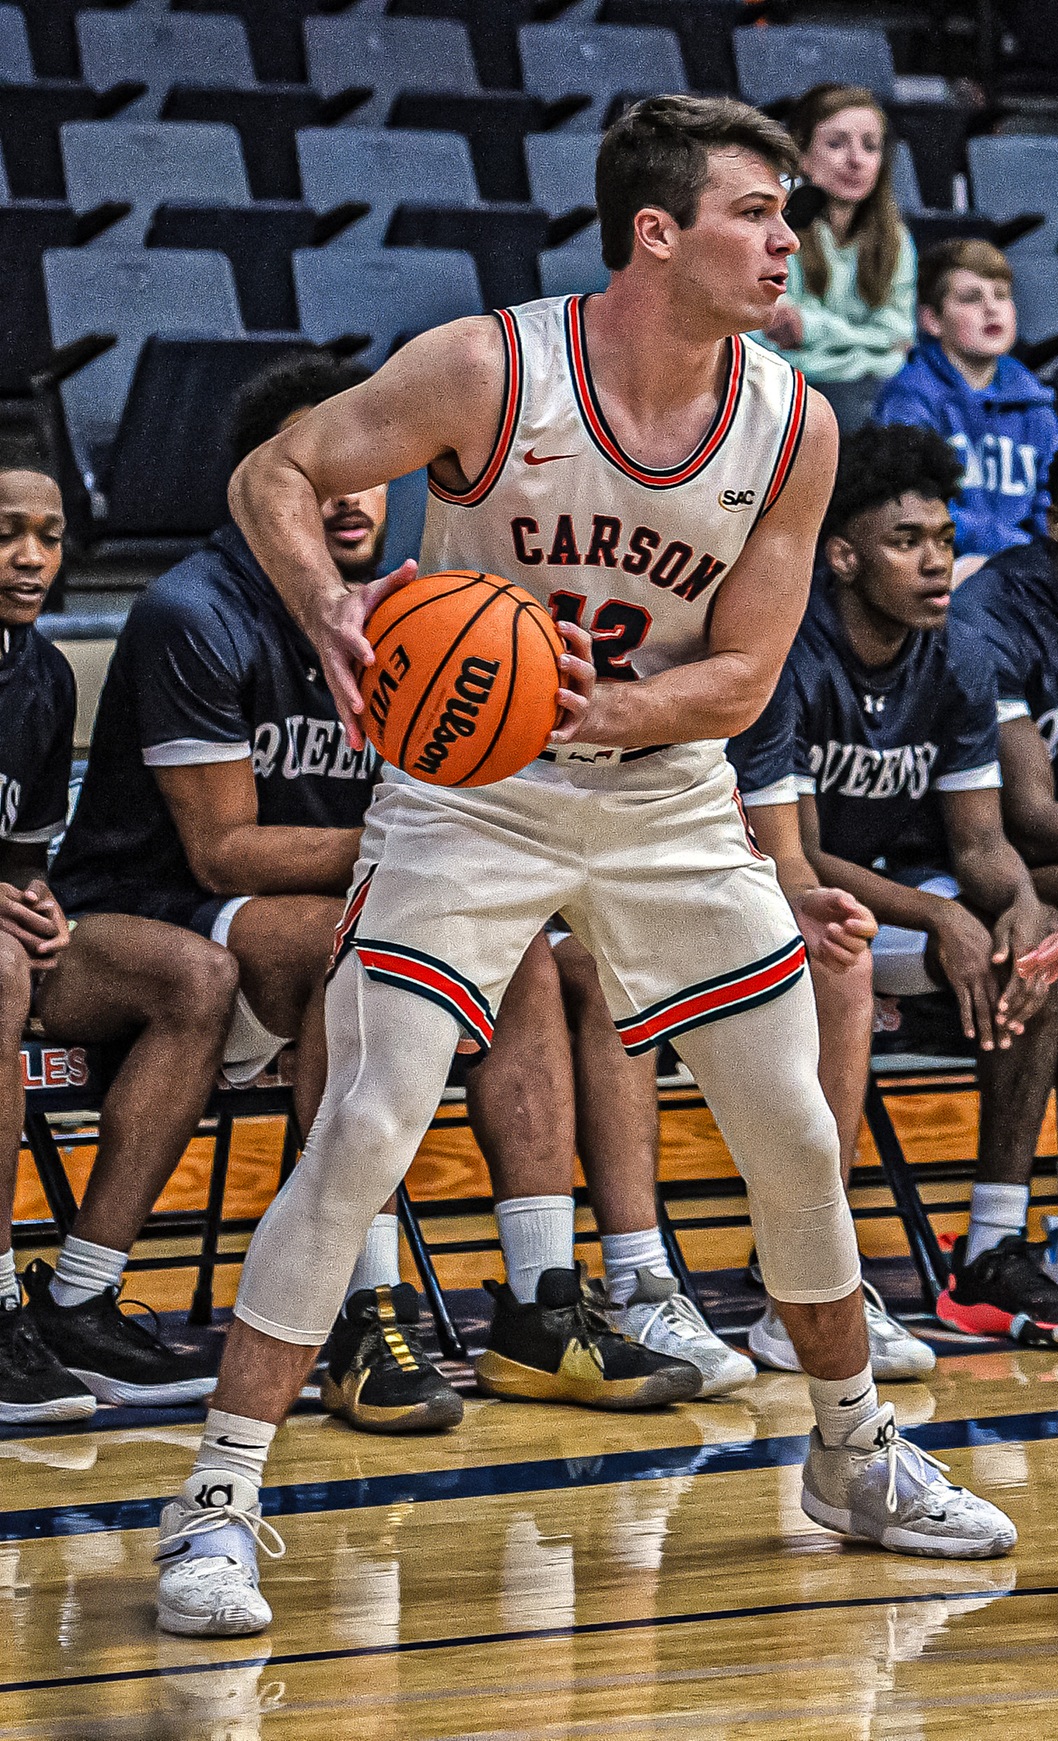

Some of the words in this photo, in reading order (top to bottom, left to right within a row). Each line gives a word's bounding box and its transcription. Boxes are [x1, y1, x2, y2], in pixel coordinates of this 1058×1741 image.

[722, 489, 756, 505] SAC
[510, 514, 728, 603] CARSON
[413, 655, 502, 775] Wilson
